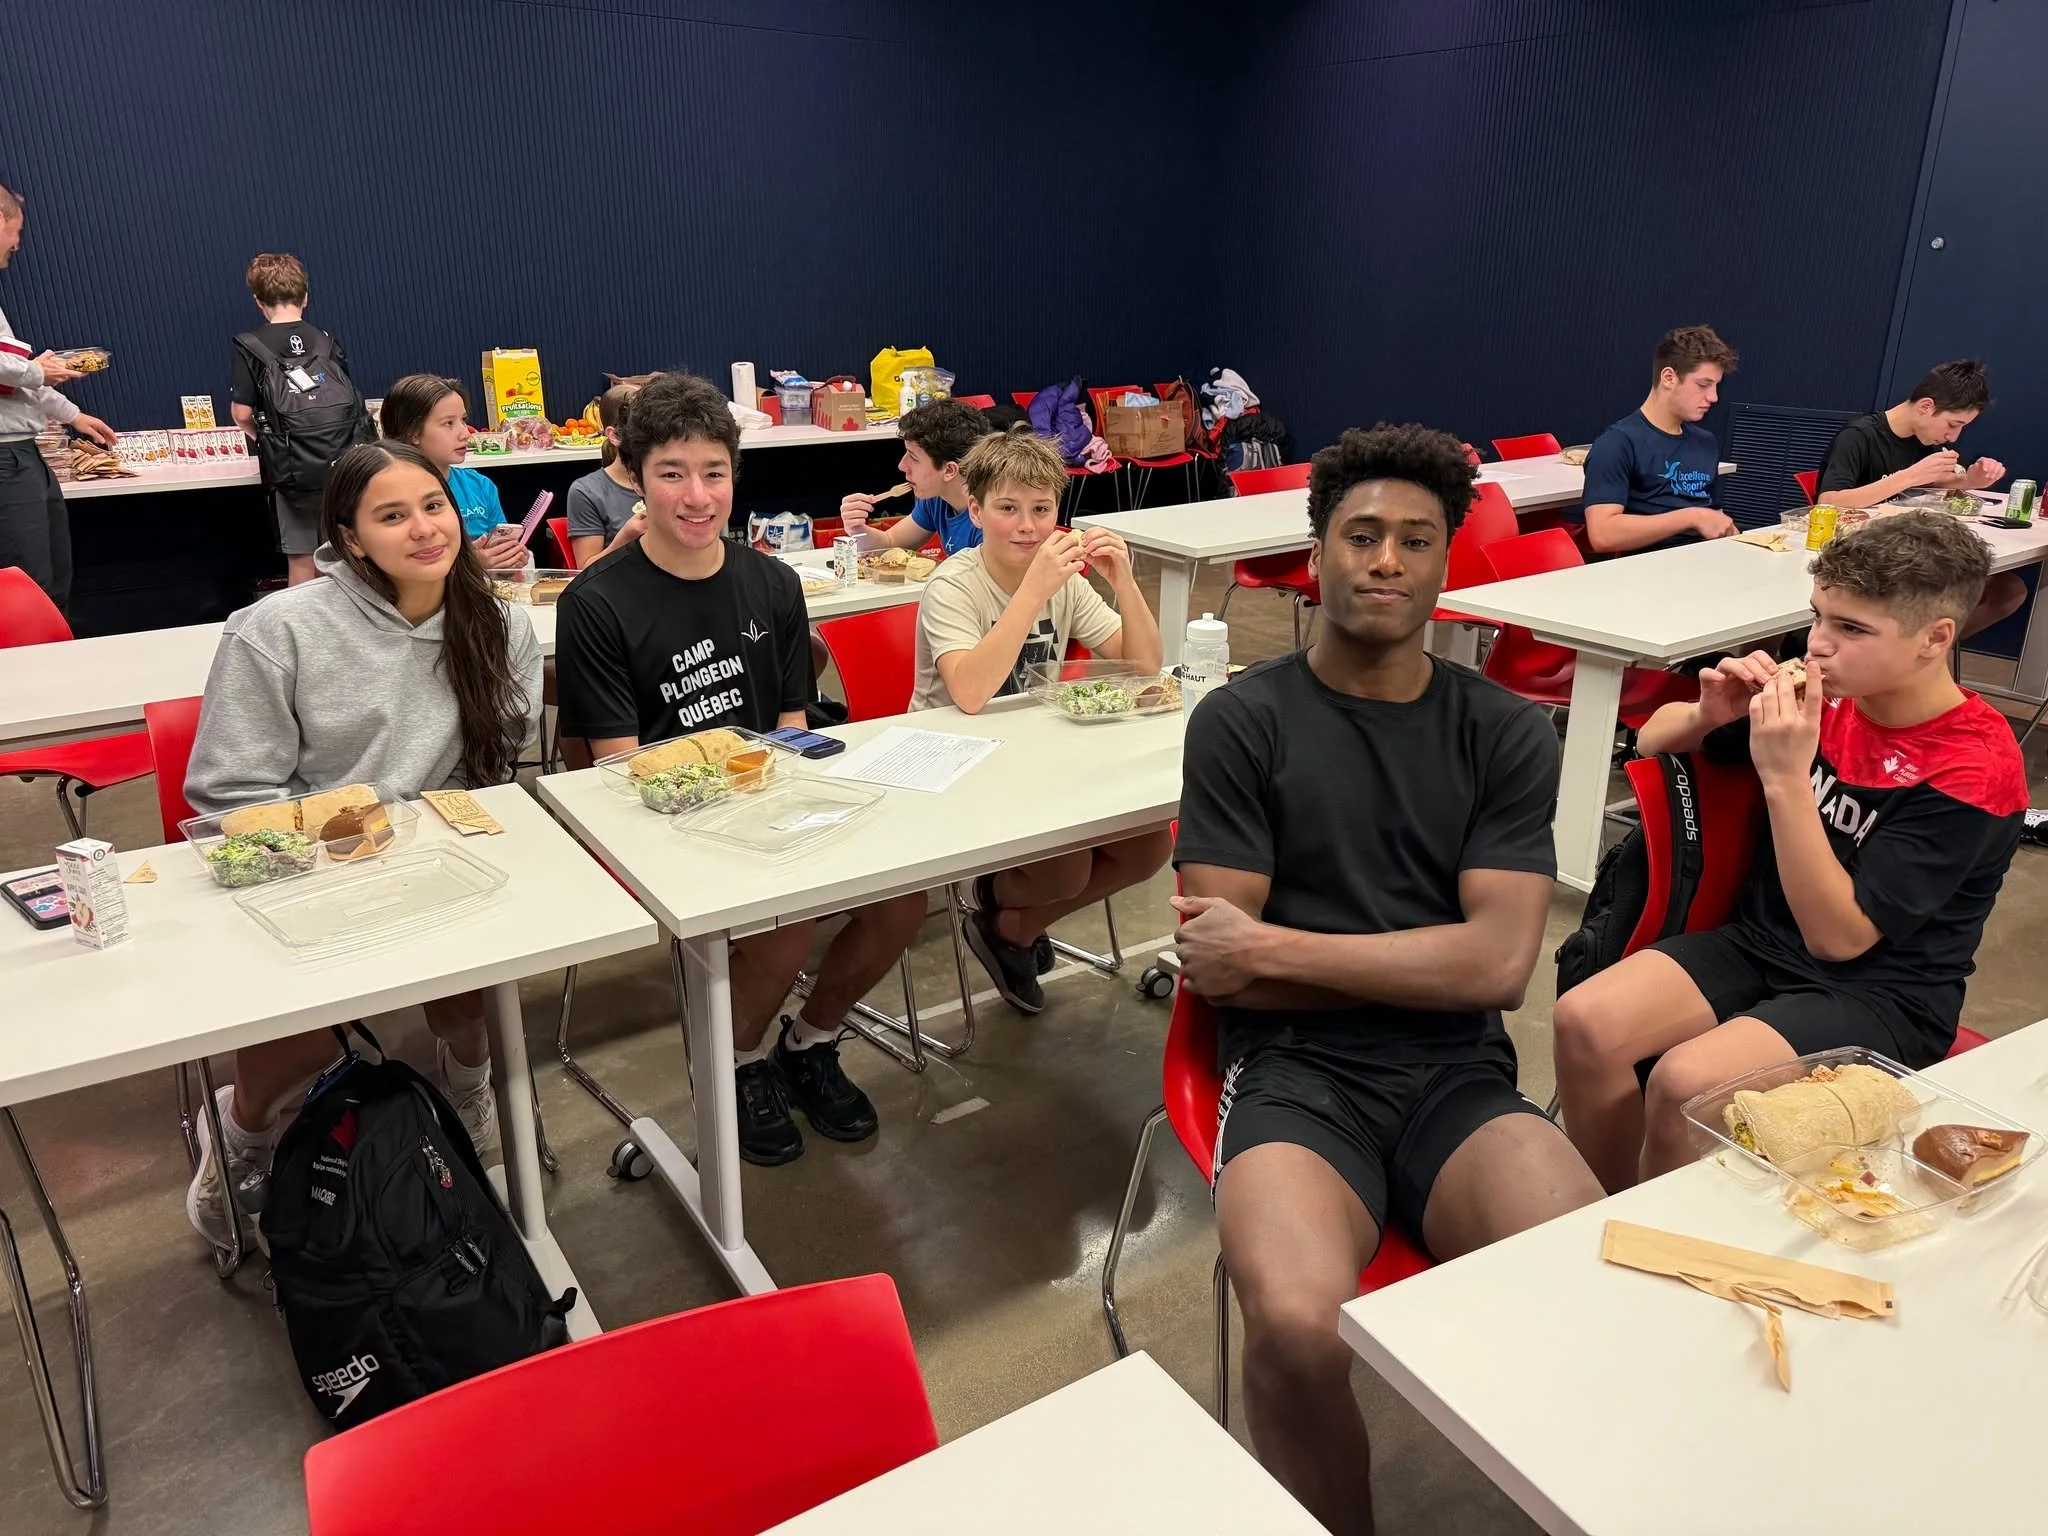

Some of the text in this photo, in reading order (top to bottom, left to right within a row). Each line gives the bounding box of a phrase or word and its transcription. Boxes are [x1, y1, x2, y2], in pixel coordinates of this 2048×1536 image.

[672, 638, 715, 673] CAMP
[659, 655, 745, 704] PLONGEON
[678, 688, 744, 727] QUÉBEC
[1675, 774, 1699, 841] speedo
[1810, 764, 1878, 848] NADA
[311, 1354, 380, 1397] speedo
